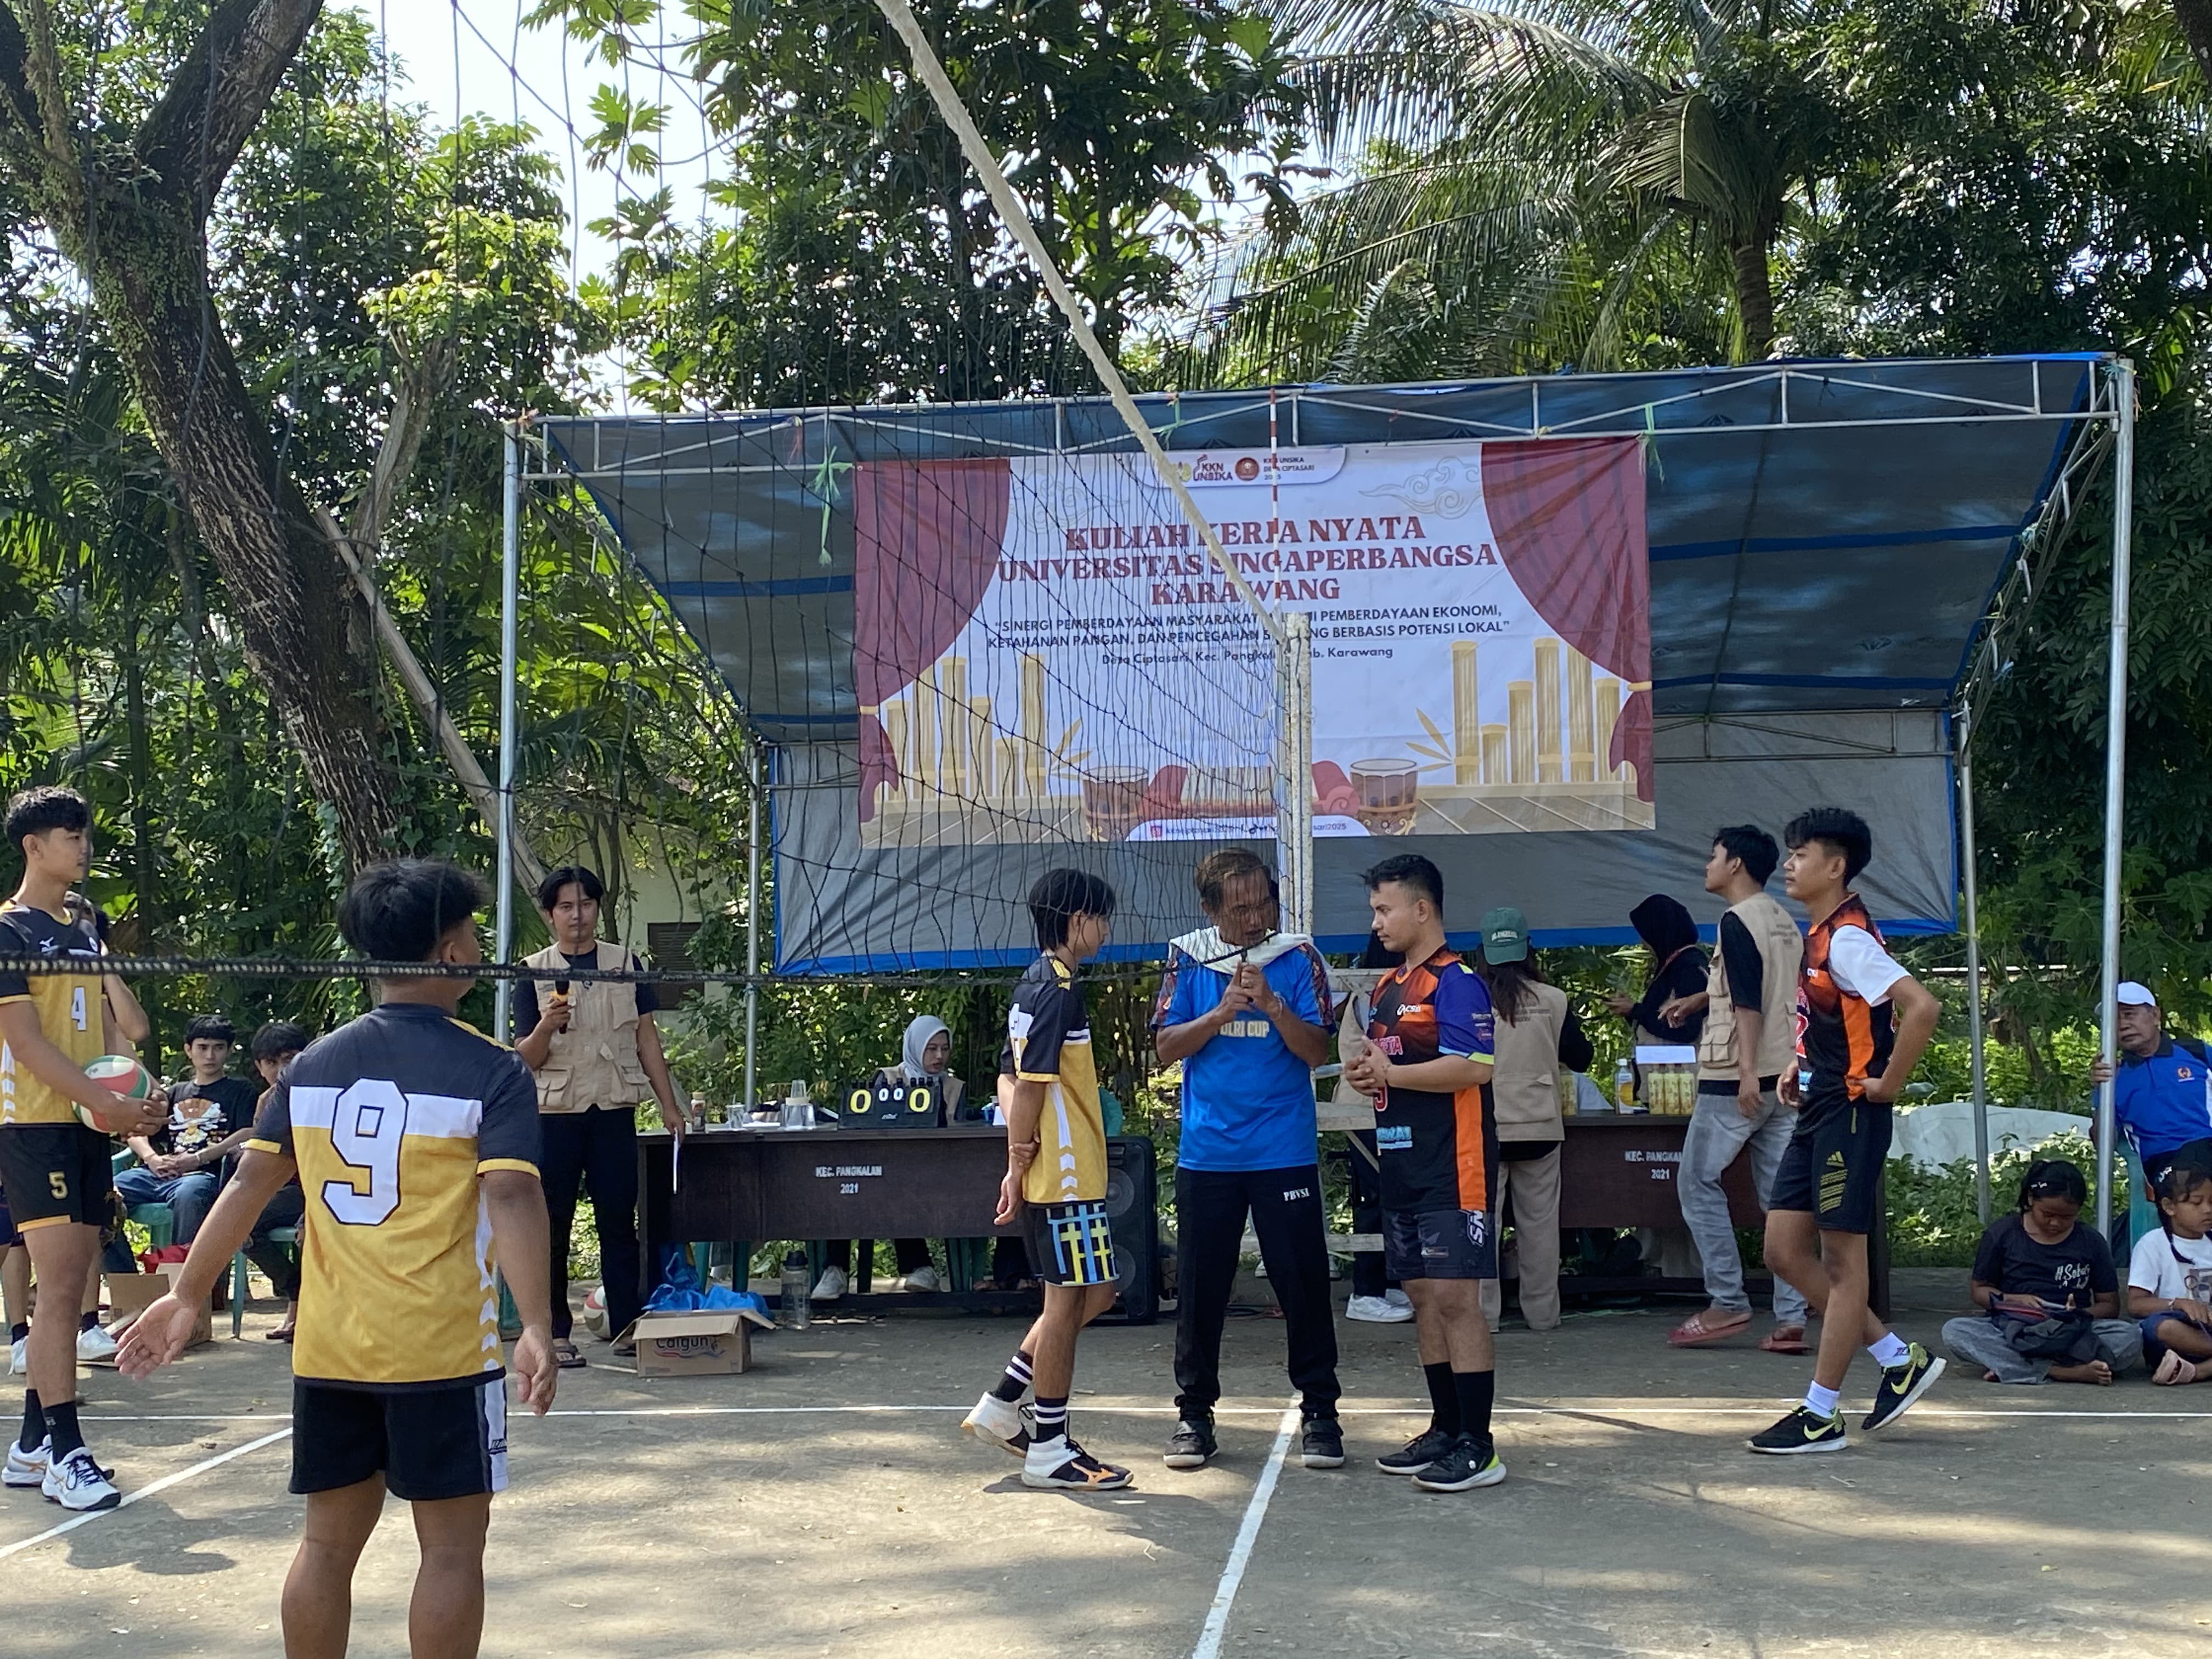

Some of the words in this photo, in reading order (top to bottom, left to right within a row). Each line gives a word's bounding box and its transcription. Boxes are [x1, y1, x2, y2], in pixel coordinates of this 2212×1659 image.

[1202, 462, 1223, 472] KKN
[1065, 524, 1189, 550] KULIAH
[1309, 516, 1426, 543] NYATA
[998, 553, 1203, 582] UNIVERSITAS
[1152, 578, 1340, 605] KARAWANG
[1057, 617, 1163, 630] PEMBERDAYAAN
[1321, 606, 1429, 622] PEMBERDAYAAN
[1433, 605, 1502, 618] EKONOMI,
[988, 635, 1069, 648] KETAHANAN
[1138, 632, 1165, 644] DAN
[1168, 630, 1259, 643] PENCEGAHAN
[1333, 624, 1395, 638] BERBASIS
[1399, 622, 1454, 635] POTENSI
[1328, 648, 1393, 658] Karawang
[71, 986, 86, 1031] 4
[1247, 1021, 1269, 1038] CUP
[850, 1090, 871, 1113] 0
[879, 1088, 889, 1102] 0
[893, 1088, 904, 1101] 0
[909, 1088, 930, 1112] 0
[321, 1077, 409, 1226] 9
[1625, 1151, 1645, 1161] KEC.
[816, 1166, 834, 1177] KEC.
[836, 1166, 882, 1176] PANGKALAN
[1651, 1169, 1670, 1179] 2021
[48, 1171, 68, 1200] 5
[840, 1182, 859, 1194] 2021
